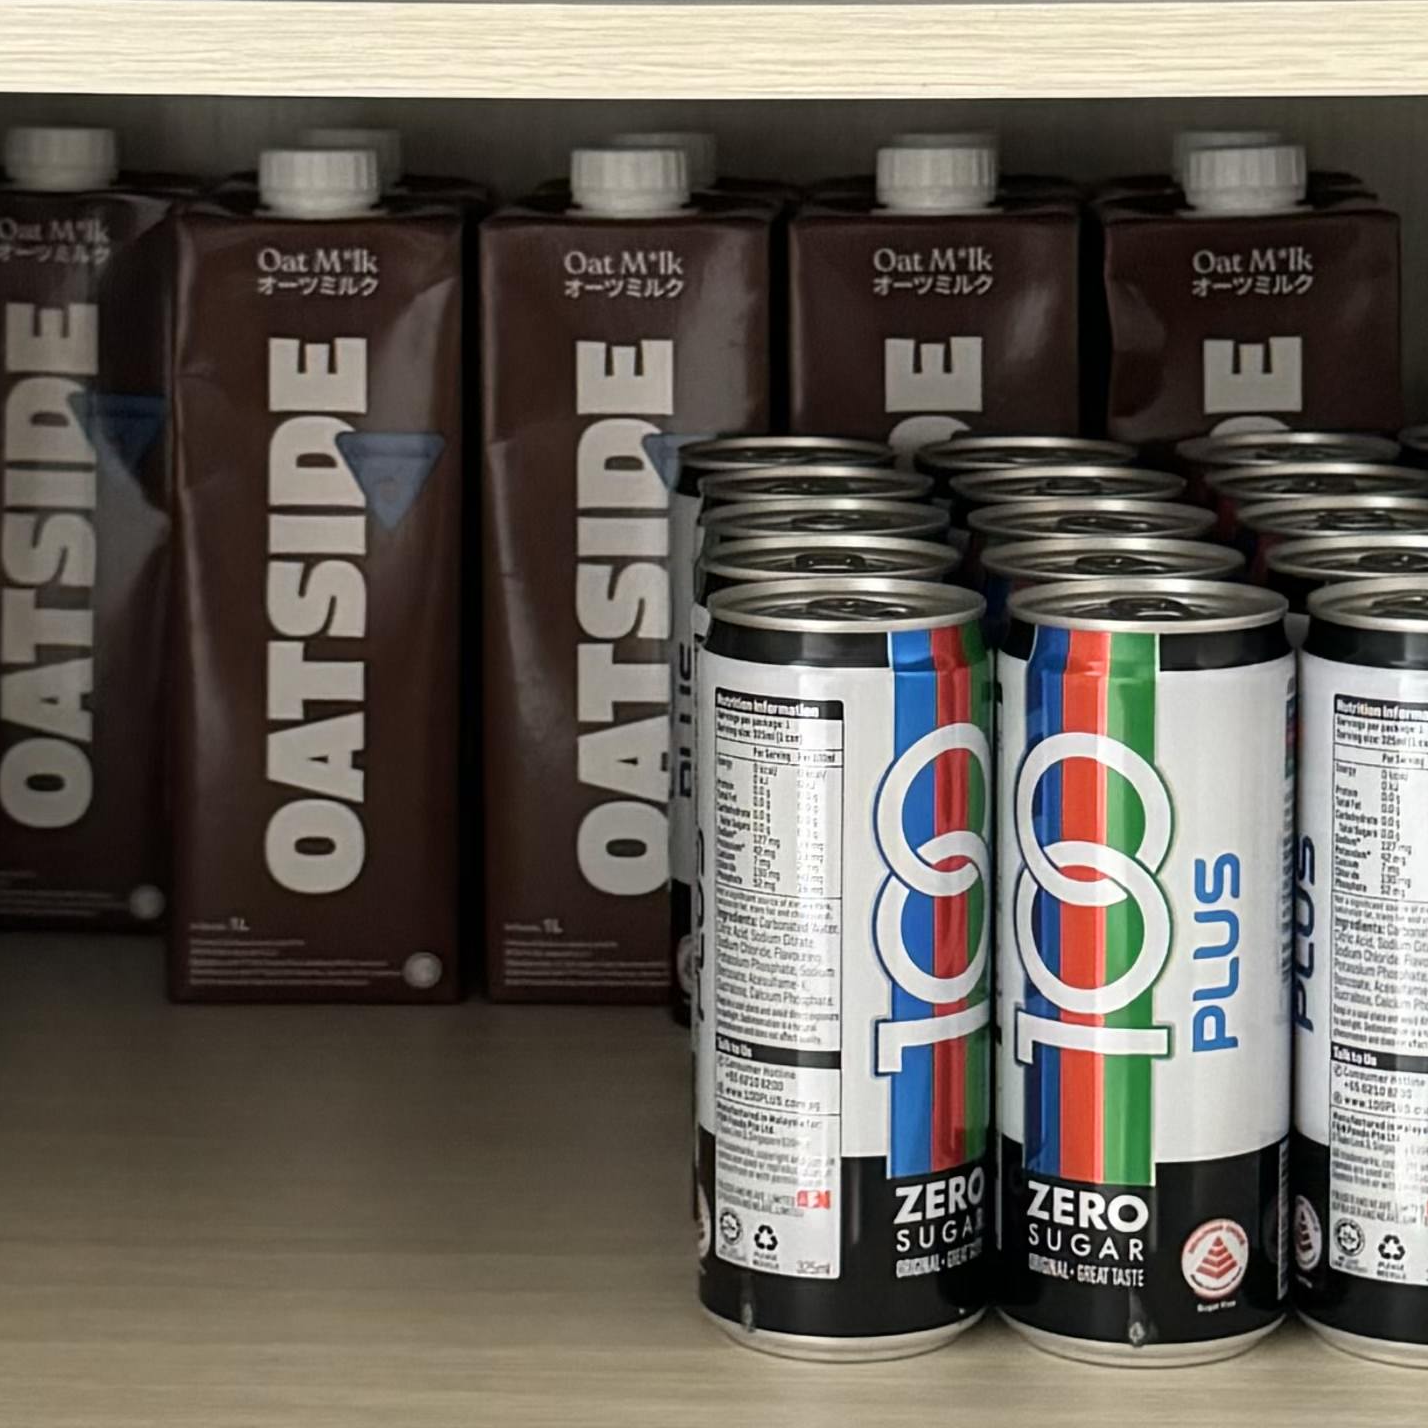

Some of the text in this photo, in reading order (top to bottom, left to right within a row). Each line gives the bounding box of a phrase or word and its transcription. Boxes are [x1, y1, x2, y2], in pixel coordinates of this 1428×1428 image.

[257, 248, 309, 273] Oat
[564, 251, 614, 276] Oat
[873, 247, 922, 272] Oat
[1192, 249, 1242, 275] Oat
[257, 275, 378, 297] オーツミルク
[564, 277, 685, 299] オーツミルク
[873, 274, 993, 297] オーツミルク
[1191, 275, 1314, 297] オーツミルク
[265, 337, 367, 894] OATSIDE
[575, 338, 674, 897] OATSIDE
[1336, 699, 1381, 718] Nutrition
[1014, 732, 1172, 1067] 100
[1192, 852, 1241, 1053] PLUS
[1333, 1045, 1378, 1067] Talk to Us
[893, 1167, 985, 1224] ZERO
[1026, 1180, 1149, 1233] ZERO
[1027, 1223, 1144, 1262] SUGAR
[1077, 1262, 1110, 1285] GREAT
[1111, 1266, 1145, 1288] TASTE
